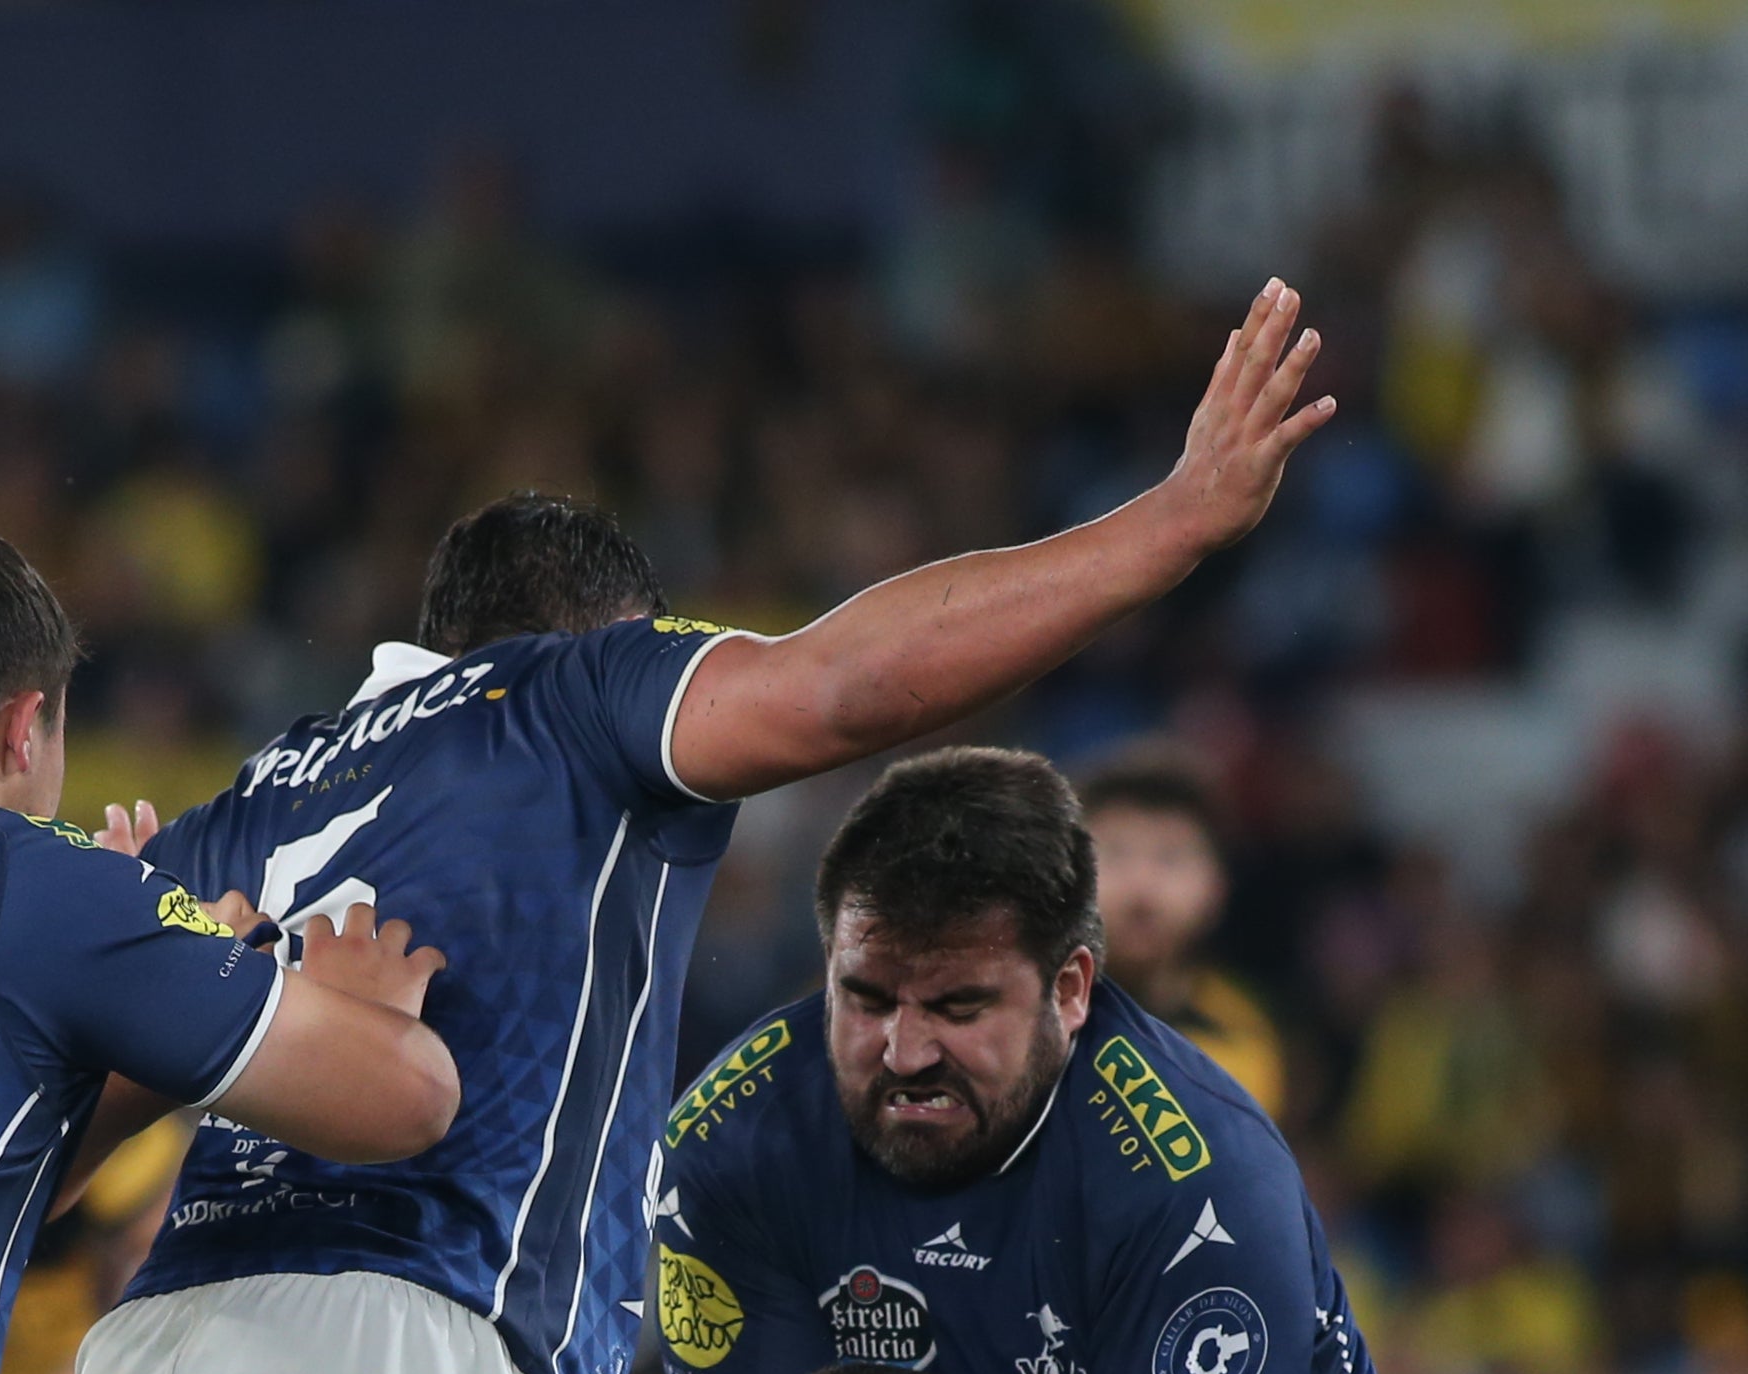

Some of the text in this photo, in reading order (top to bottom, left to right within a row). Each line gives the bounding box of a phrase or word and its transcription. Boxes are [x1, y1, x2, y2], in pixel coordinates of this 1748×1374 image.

[666, 1020, 790, 1147] RKD
[696, 1066, 776, 1142] PIVOT
[1096, 1038, 1208, 1177] RKD
[1087, 1089, 1153, 1173] PIVOT
[912, 1247, 992, 1271] ERCURY
